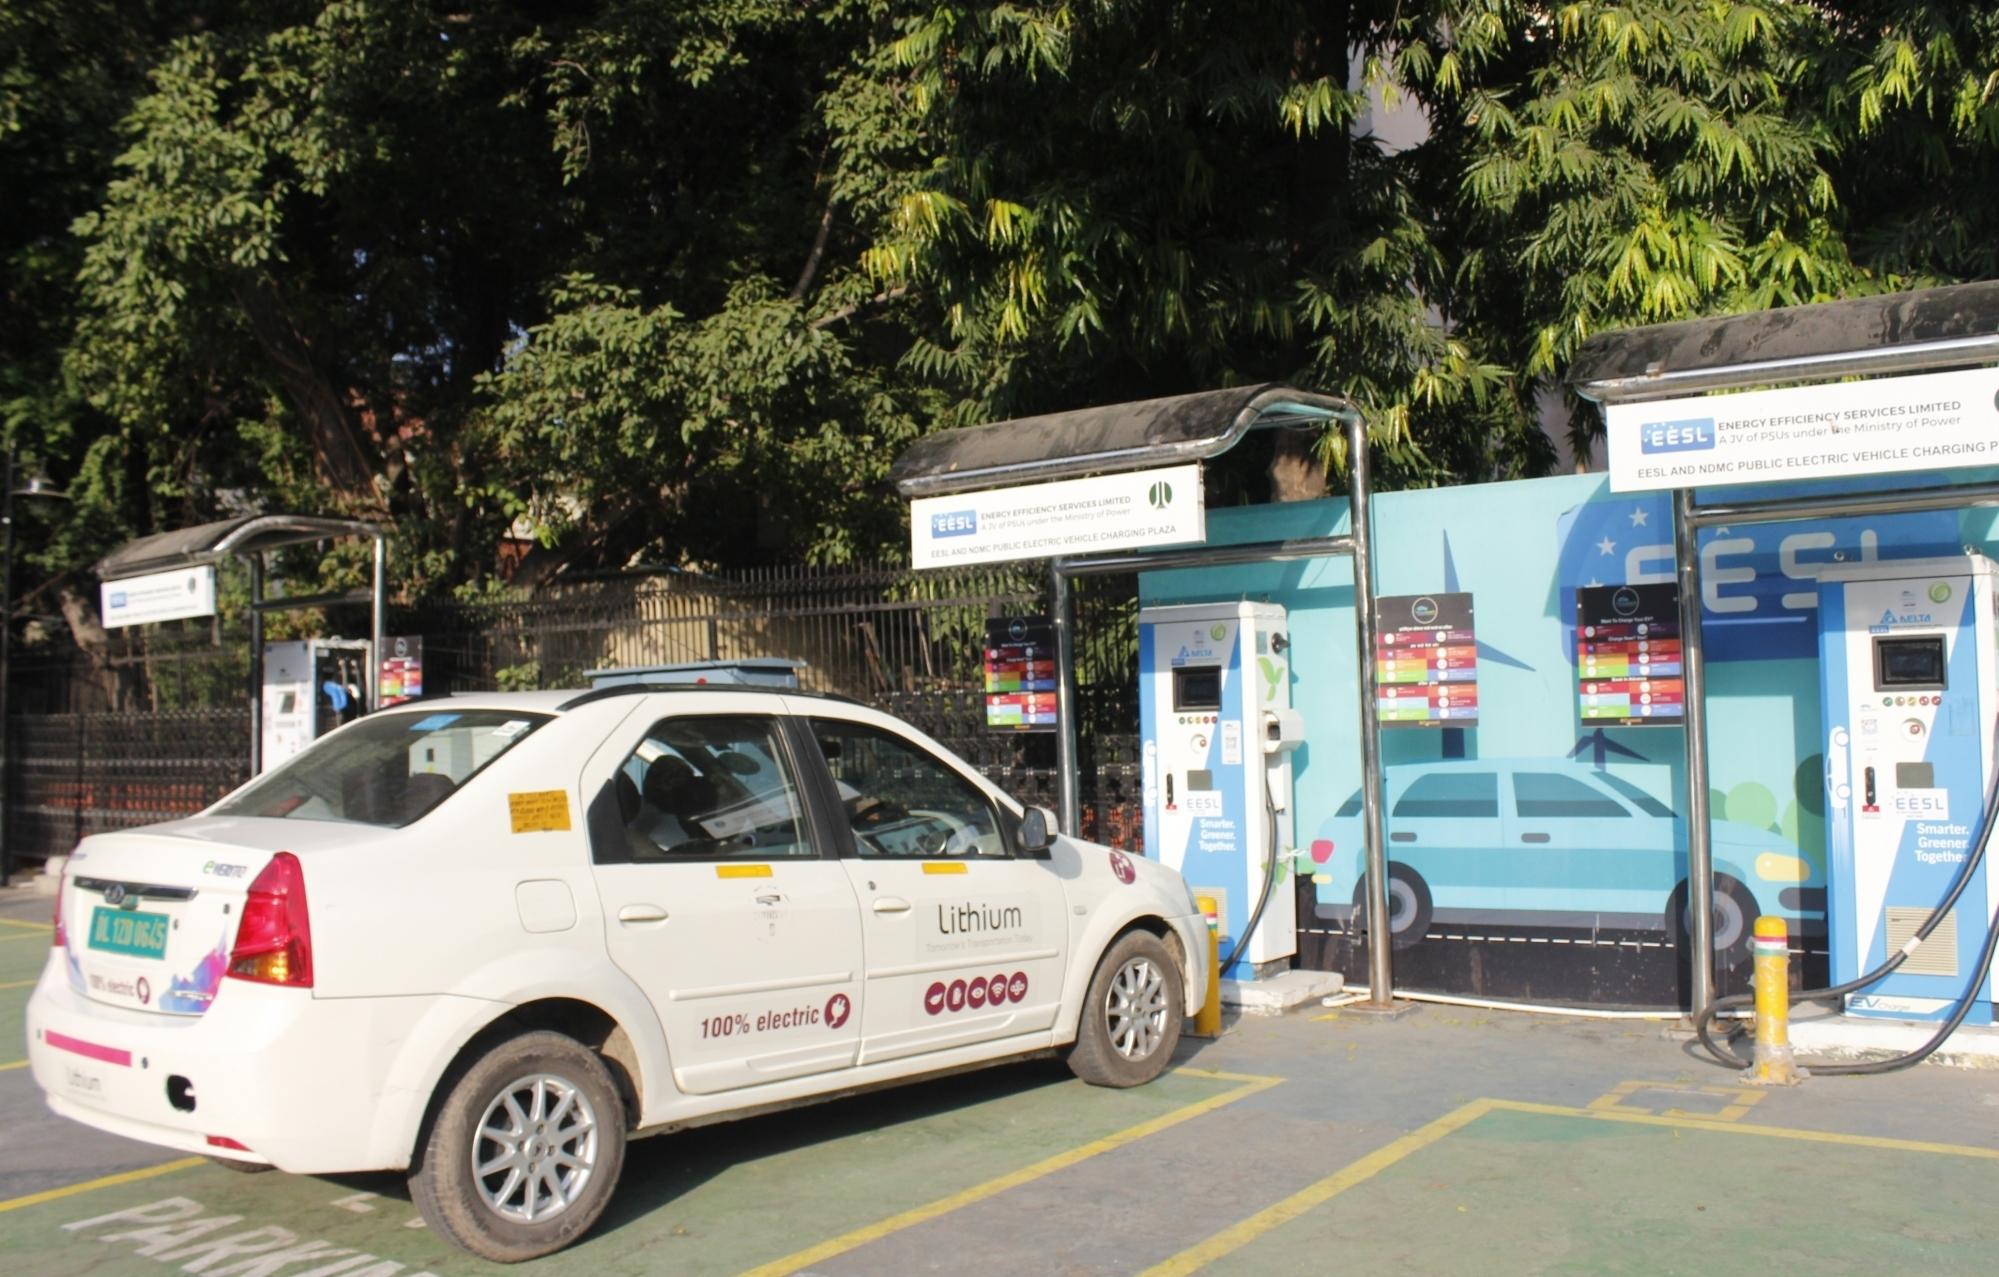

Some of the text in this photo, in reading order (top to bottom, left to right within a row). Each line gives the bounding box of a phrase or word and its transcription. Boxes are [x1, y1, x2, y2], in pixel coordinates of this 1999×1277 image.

[1718, 401, 1961, 431] ENERGY EFFICIENCY SERVICES LIMITED
[1652, 427, 1708, 447] EESL
[1719, 436, 1727, 445] A
[1730, 434, 1743, 444] JV
[1746, 432, 1758, 442] of
[1760, 430, 1790, 441] PSUs
[1795, 427, 1827, 438] under
[1854, 420, 1903, 433] Ministry
[1906, 418, 1918, 429] of
[1921, 416, 1961, 428] Power
[1638, 468, 1668, 479] EESL
[1671, 465, 1696, 476] AND
[1699, 462, 1734, 474] NDMC
[1738, 458, 1783, 471] PUBLIC
[1787, 453, 1849, 467] ELECTRIC
[1853, 448, 1908, 462] VEHICLE
[1912, 441, 1986, 457] CHARGING
[981, 496, 1131, 520] ENERGY EFFICIENCY SERVICES LIMITED
[1027, 516, 1049, 526] under
[1051, 514, 1063, 523] the
[1065, 510, 1094, 521] Ministry
[1096, 508, 1104, 518] of
[1106, 508, 1130, 517] Power
[938, 516, 974, 532] EESL
[951, 547, 967, 556] AND
[992, 542, 1021, 552] PUBLIC
[1023, 537, 1061, 548] ELECTRIC
[1064, 532, 1099, 544] VEHICLE
[1100, 528, 1146, 541] CHARGING
[1148, 525, 1176, 536] PLAZA
[1187, 798, 1219, 809] EESL
[1896, 798, 1944, 810] EESL
[1916, 823, 1969, 835] Smarter.
[1914, 850, 1968, 865] Together
[938, 901, 1022, 934] Lithium
[701, 1005, 819, 1039] 100% electric
